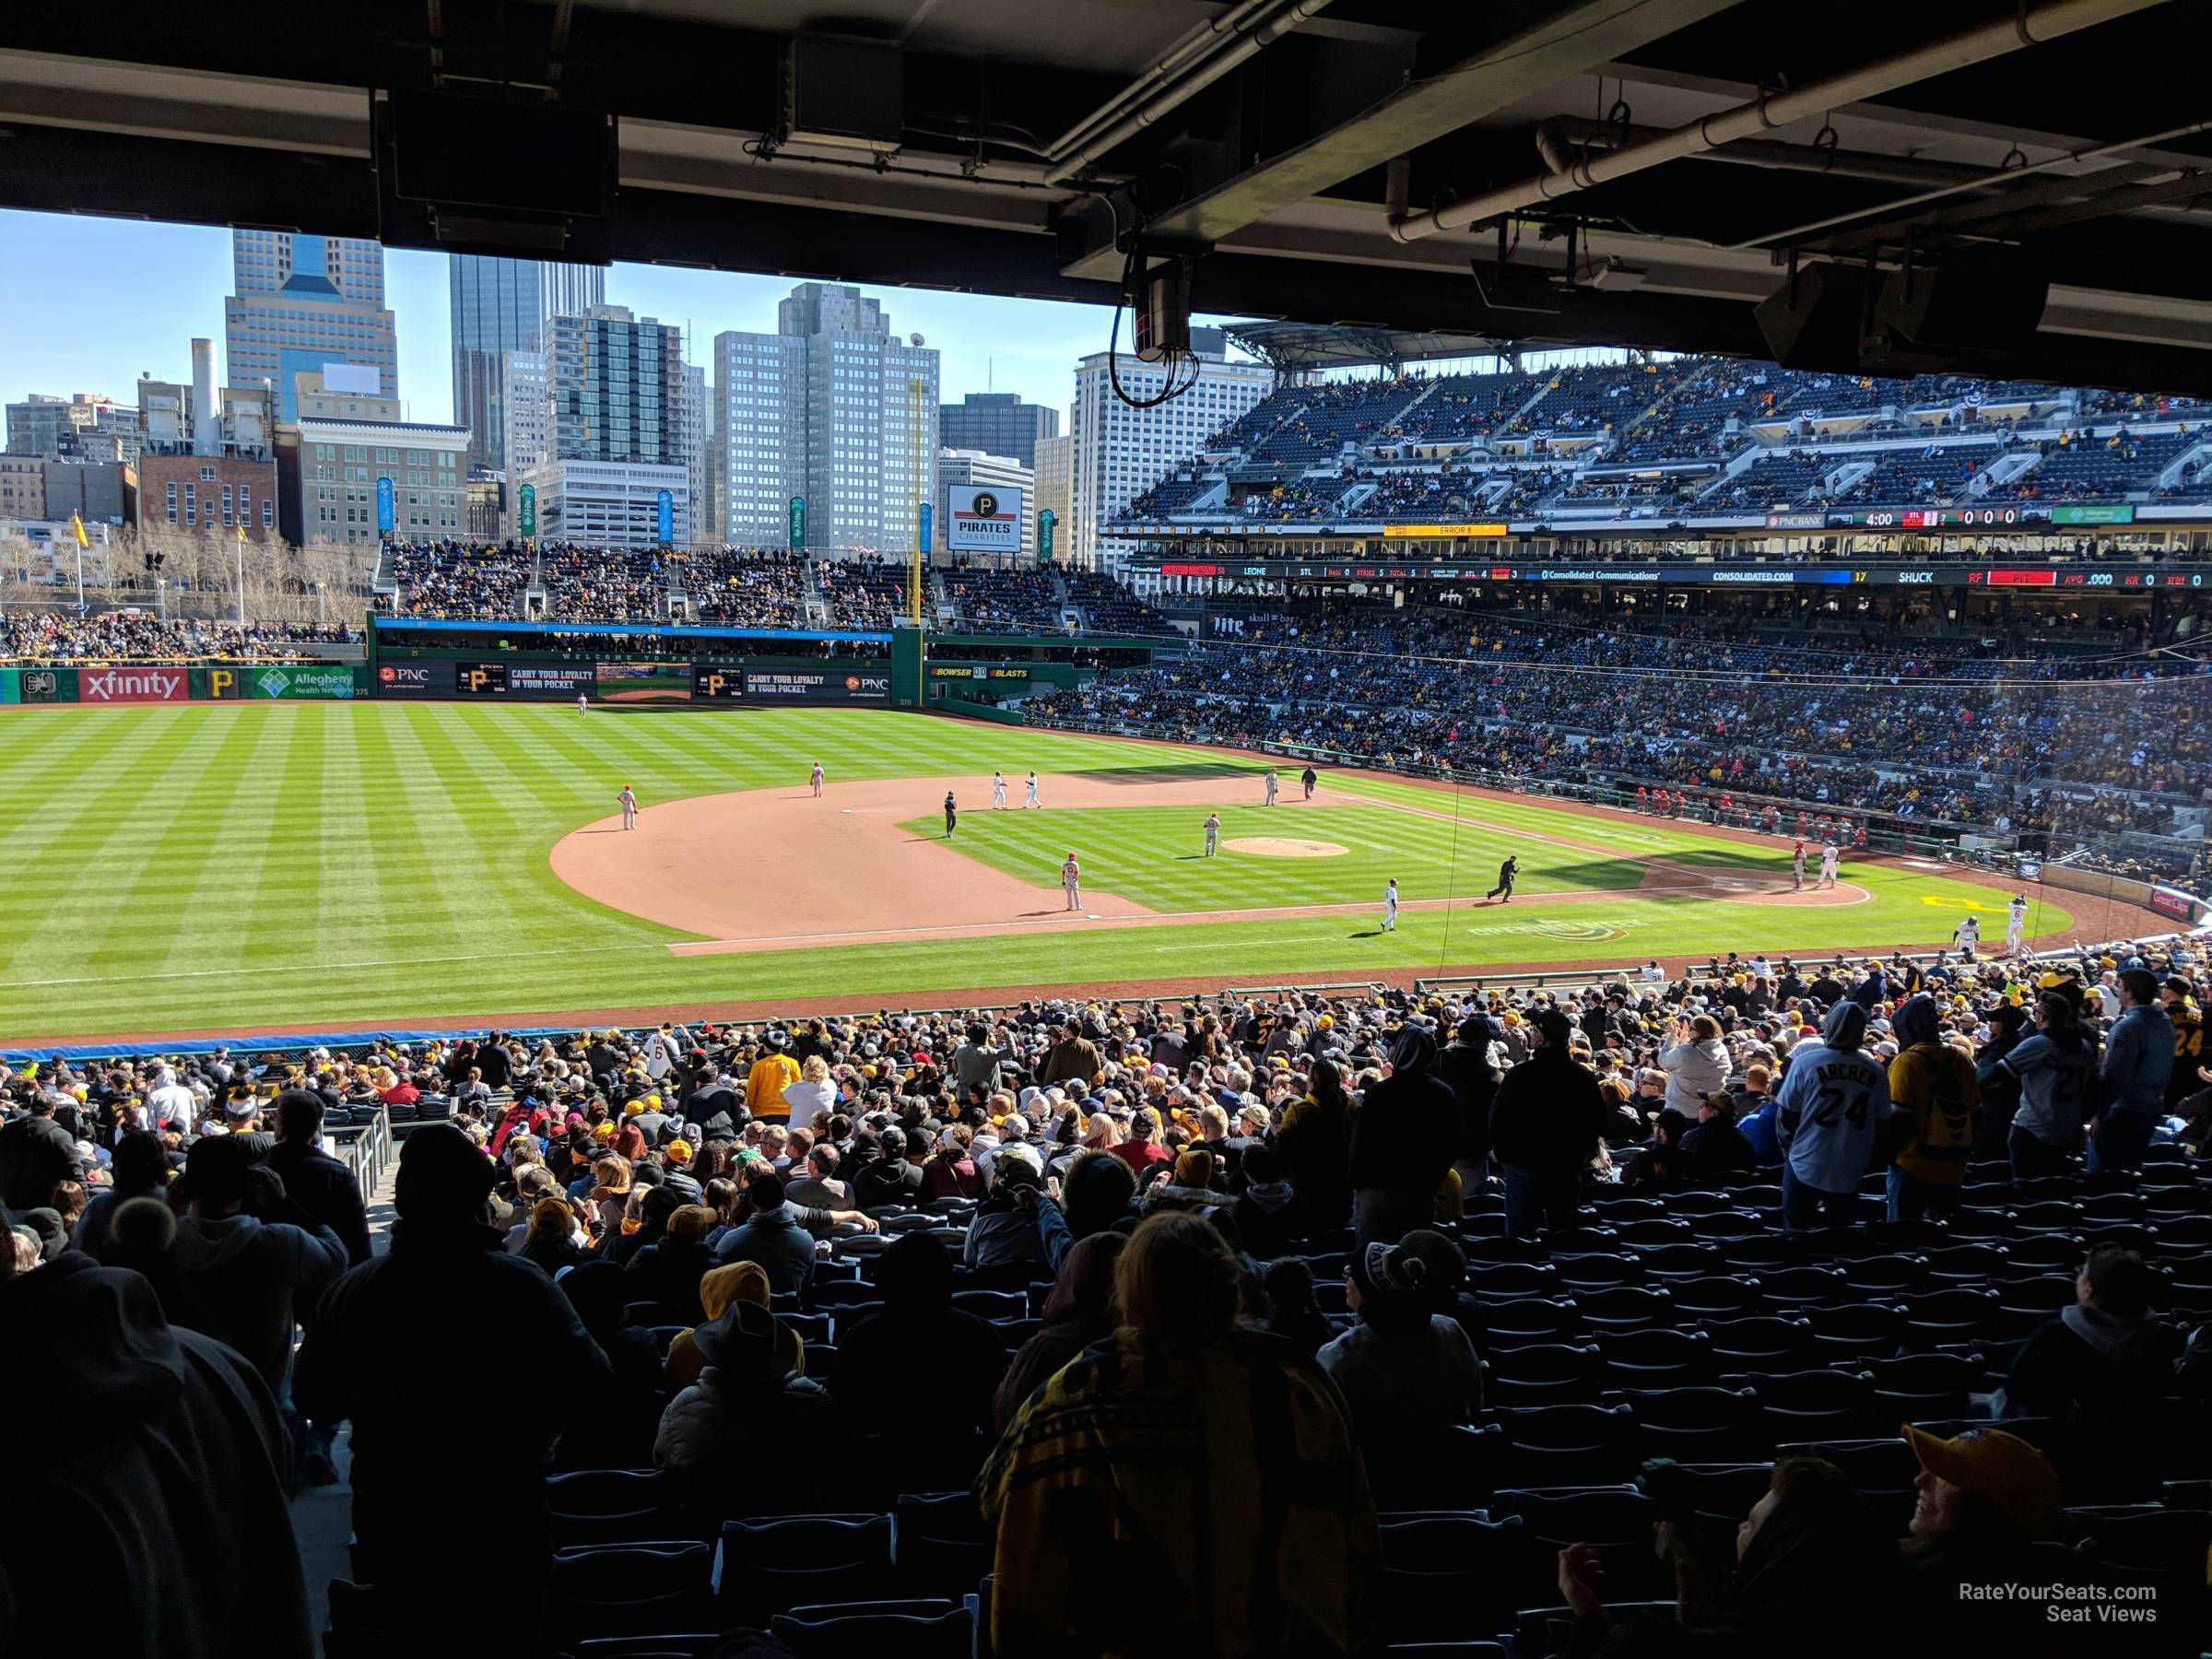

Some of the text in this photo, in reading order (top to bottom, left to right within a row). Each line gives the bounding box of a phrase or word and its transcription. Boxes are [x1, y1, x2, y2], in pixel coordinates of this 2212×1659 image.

[980, 498, 992, 513] P
[1779, 516, 1822, 526] PNC BANK
[1865, 513, 1892, 525] 4:00
[1964, 510, 2015, 524] 0 0 0
[959, 522, 1010, 534] PIRATES
[1440, 526, 1465, 535] ERROR
[959, 534, 1011, 542] CHARITIES
[1243, 567, 1266, 576] LEONE
[1300, 568, 1312, 576] STL
[1345, 568, 1350, 576] 0
[1379, 569, 1384, 577] 5
[1410, 569, 1416, 577] 5
[1481, 570, 1487, 579] 4
[1512, 570, 1518, 579] 3
[1549, 571, 1659, 581] Consolidated Communications
[1712, 571, 1794, 582] CONSOLIDATED.COM
[1855, 571, 1866, 582] 17
[1899, 571, 1934, 582] SHUCK
[1968, 572, 1983, 583] RF
[2065, 574, 2084, 584] AVG
[2086, 573, 2113, 585] .000
[2124, 575, 2139, 585] HR
[2146, 574, 2155, 586] 0
[2168, 576, 2185, 585] RBI
[2193, 574, 2202, 586] 0
[1248, 612, 1270, 622] skull
[396, 669, 429, 681] PNC
[512, 669, 536, 679] CARRY
[538, 670, 559, 679] YOUR
[560, 670, 593, 680] LOYALTY
[936, 668, 971, 677] BOWSER
[995, 669, 1028, 677] BLASTS
[211, 670, 233, 699] P
[295, 673, 354, 686] Allegheny
[512, 680, 575, 689] IN YOUR POCKET.
[747, 675, 824, 685] CARRY YOUR LOYALTY
[861, 678, 889, 690] PNC
[88, 671, 181, 700] xfinity
[747, 684, 756, 693] IN
[758, 685, 777, 693] YOUR
[778, 685, 807, 694] POCKET.
[355, 688, 369, 696] 375
[654, 1046, 663, 1060] 6
[1816, 1063, 1877, 1089] ARCHER
[1815, 1087, 1871, 1132] 24
